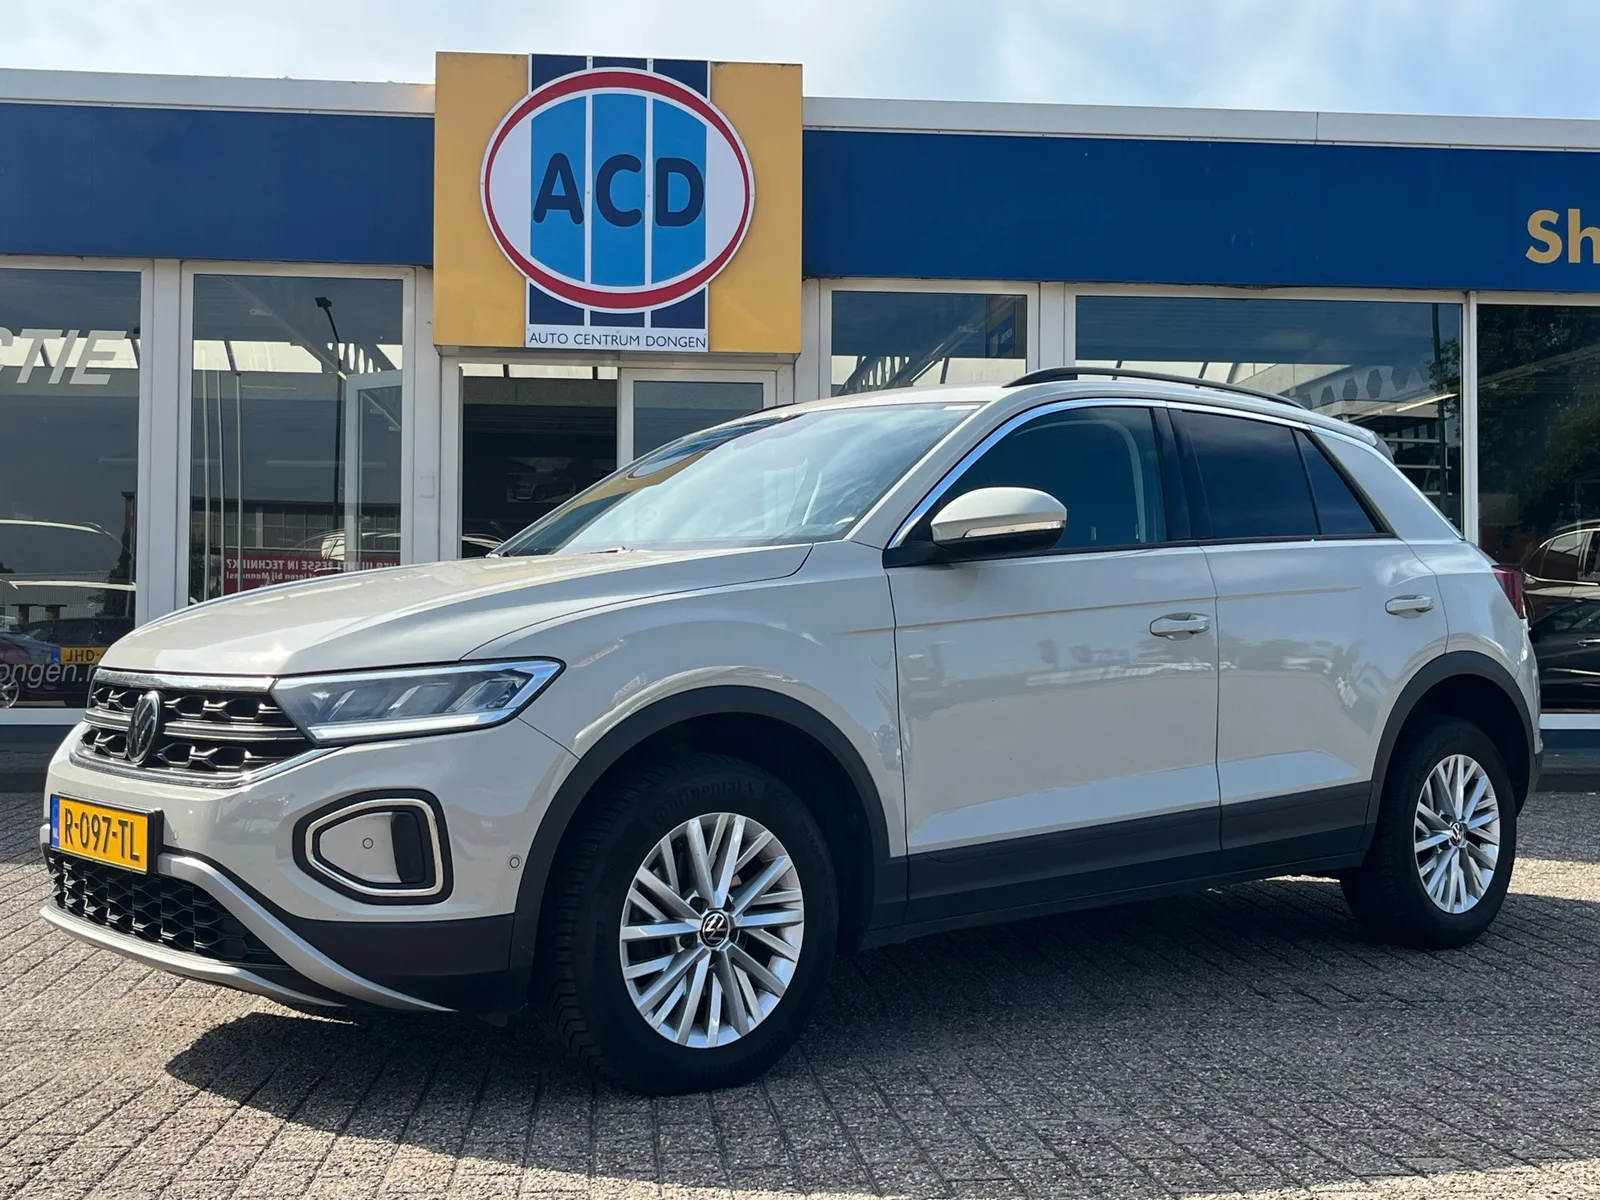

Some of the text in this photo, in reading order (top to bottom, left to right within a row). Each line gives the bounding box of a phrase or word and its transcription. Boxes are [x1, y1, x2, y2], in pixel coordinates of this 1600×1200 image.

[532, 152, 706, 227] ACD
[529, 332, 706, 349] AUTO CENTRUM DONGEN
[64, 807, 140, 862] R-097-TL
